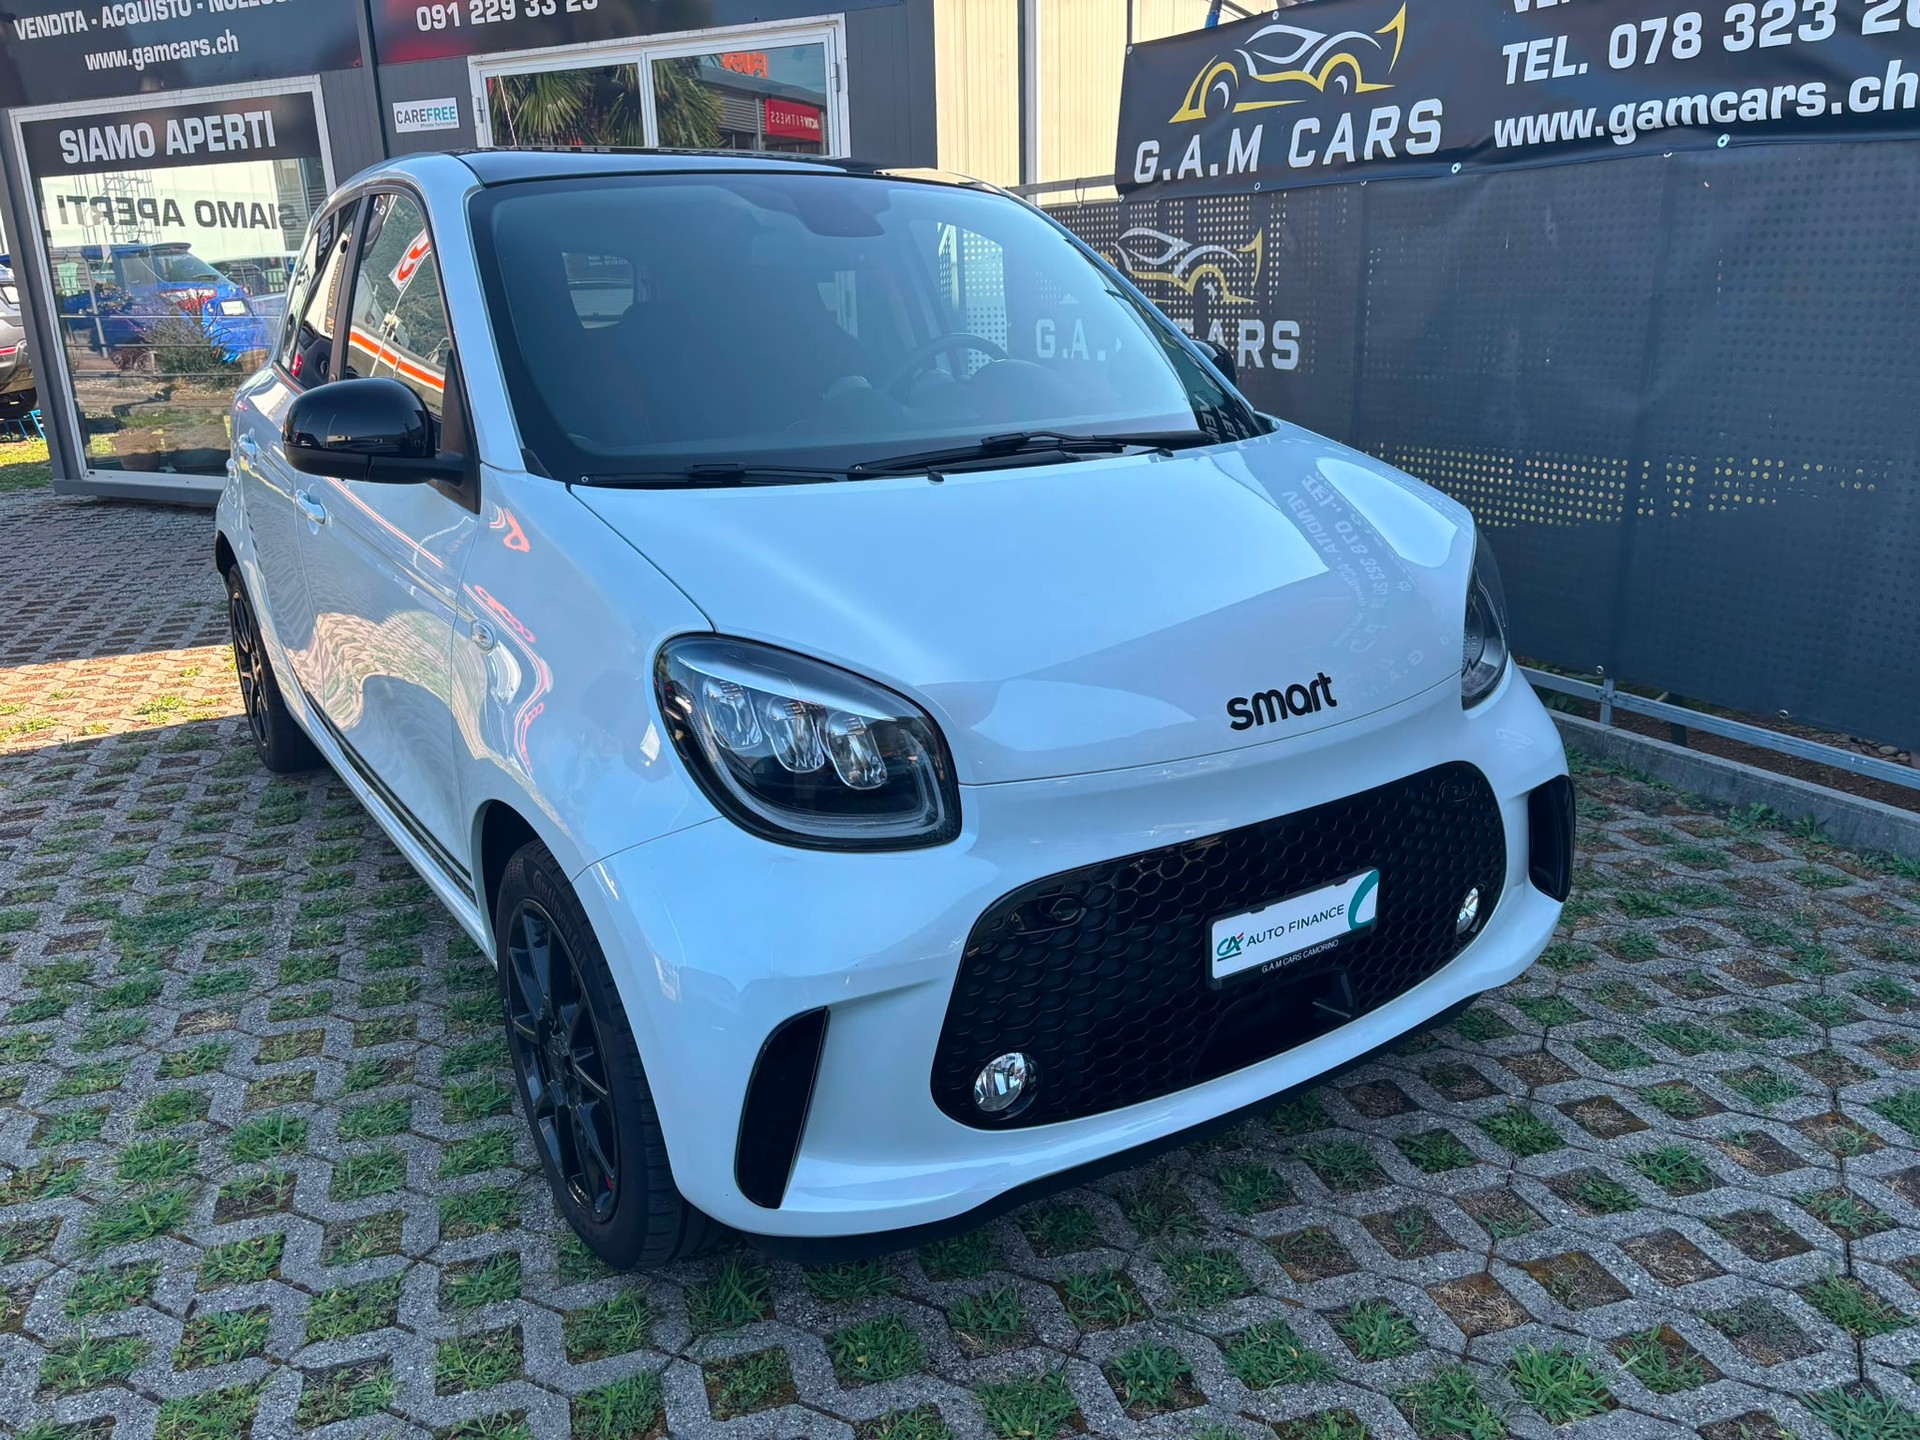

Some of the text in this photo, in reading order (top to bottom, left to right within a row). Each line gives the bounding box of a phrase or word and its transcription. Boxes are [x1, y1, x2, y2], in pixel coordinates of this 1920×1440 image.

[14, 10, 88, 40] VENDITA
[102, 0, 192, 29] ACQUISTO
[416, 2, 461, 31] 091
[469, 0, 517, 25] 229
[85, 29, 239, 71] www.gamcars.ch
[1502, 35, 1589, 85] TEL.
[1608, 12, 1702, 70] 078
[1723, 0, 1837, 52] 323
[396, 106, 457, 124] CAREFREE
[1494, 59, 1919, 148] www.gamcars.ch
[59, 110, 276, 164] SIAMO APERTI
[1134, 98, 1443, 184] G.A.M CARS
[1226, 672, 1338, 731] smart
[1246, 926, 1285, 947] AUTO
[1288, 904, 1345, 933] FINANCE
[1282, 953, 1302, 966] CARS
[1302, 939, 1339, 959] CAMORINO
